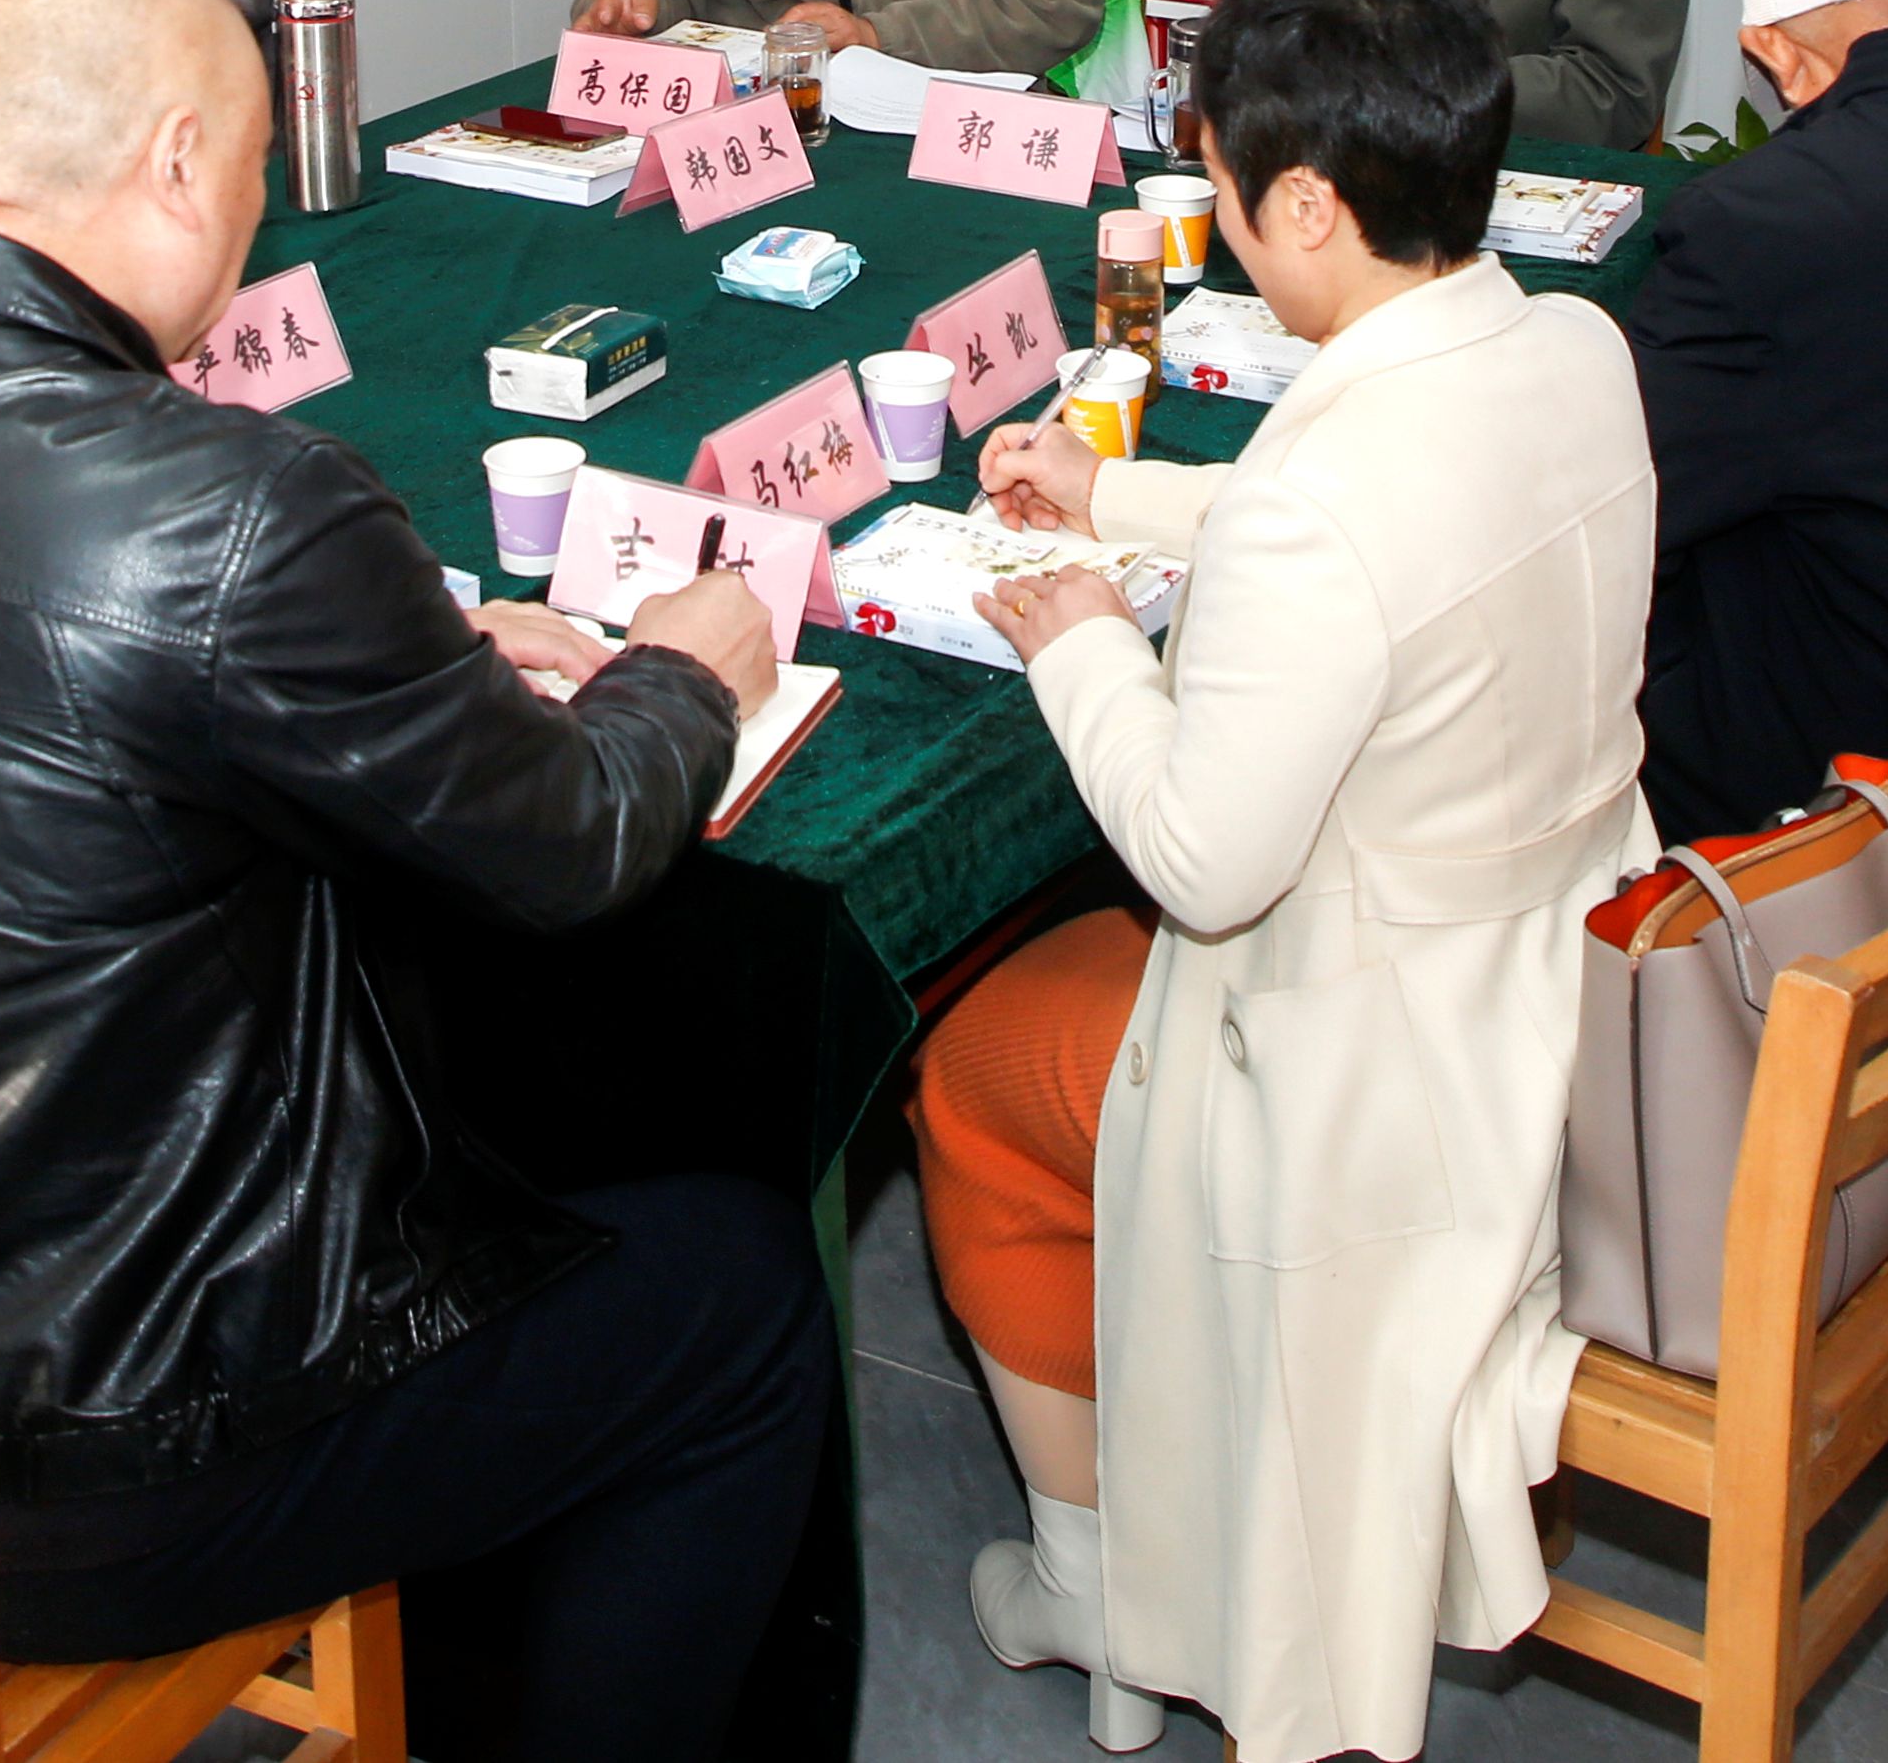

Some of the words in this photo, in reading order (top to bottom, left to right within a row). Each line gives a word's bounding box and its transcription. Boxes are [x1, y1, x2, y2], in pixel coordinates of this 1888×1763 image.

[577, 59, 692, 114] 高保国
[684, 124, 789, 192] 韩国文
[957, 110, 1060, 172] 郭谦
[966, 310, 1038, 387] 丛凯
[750, 419, 855, 510] 马红梅
